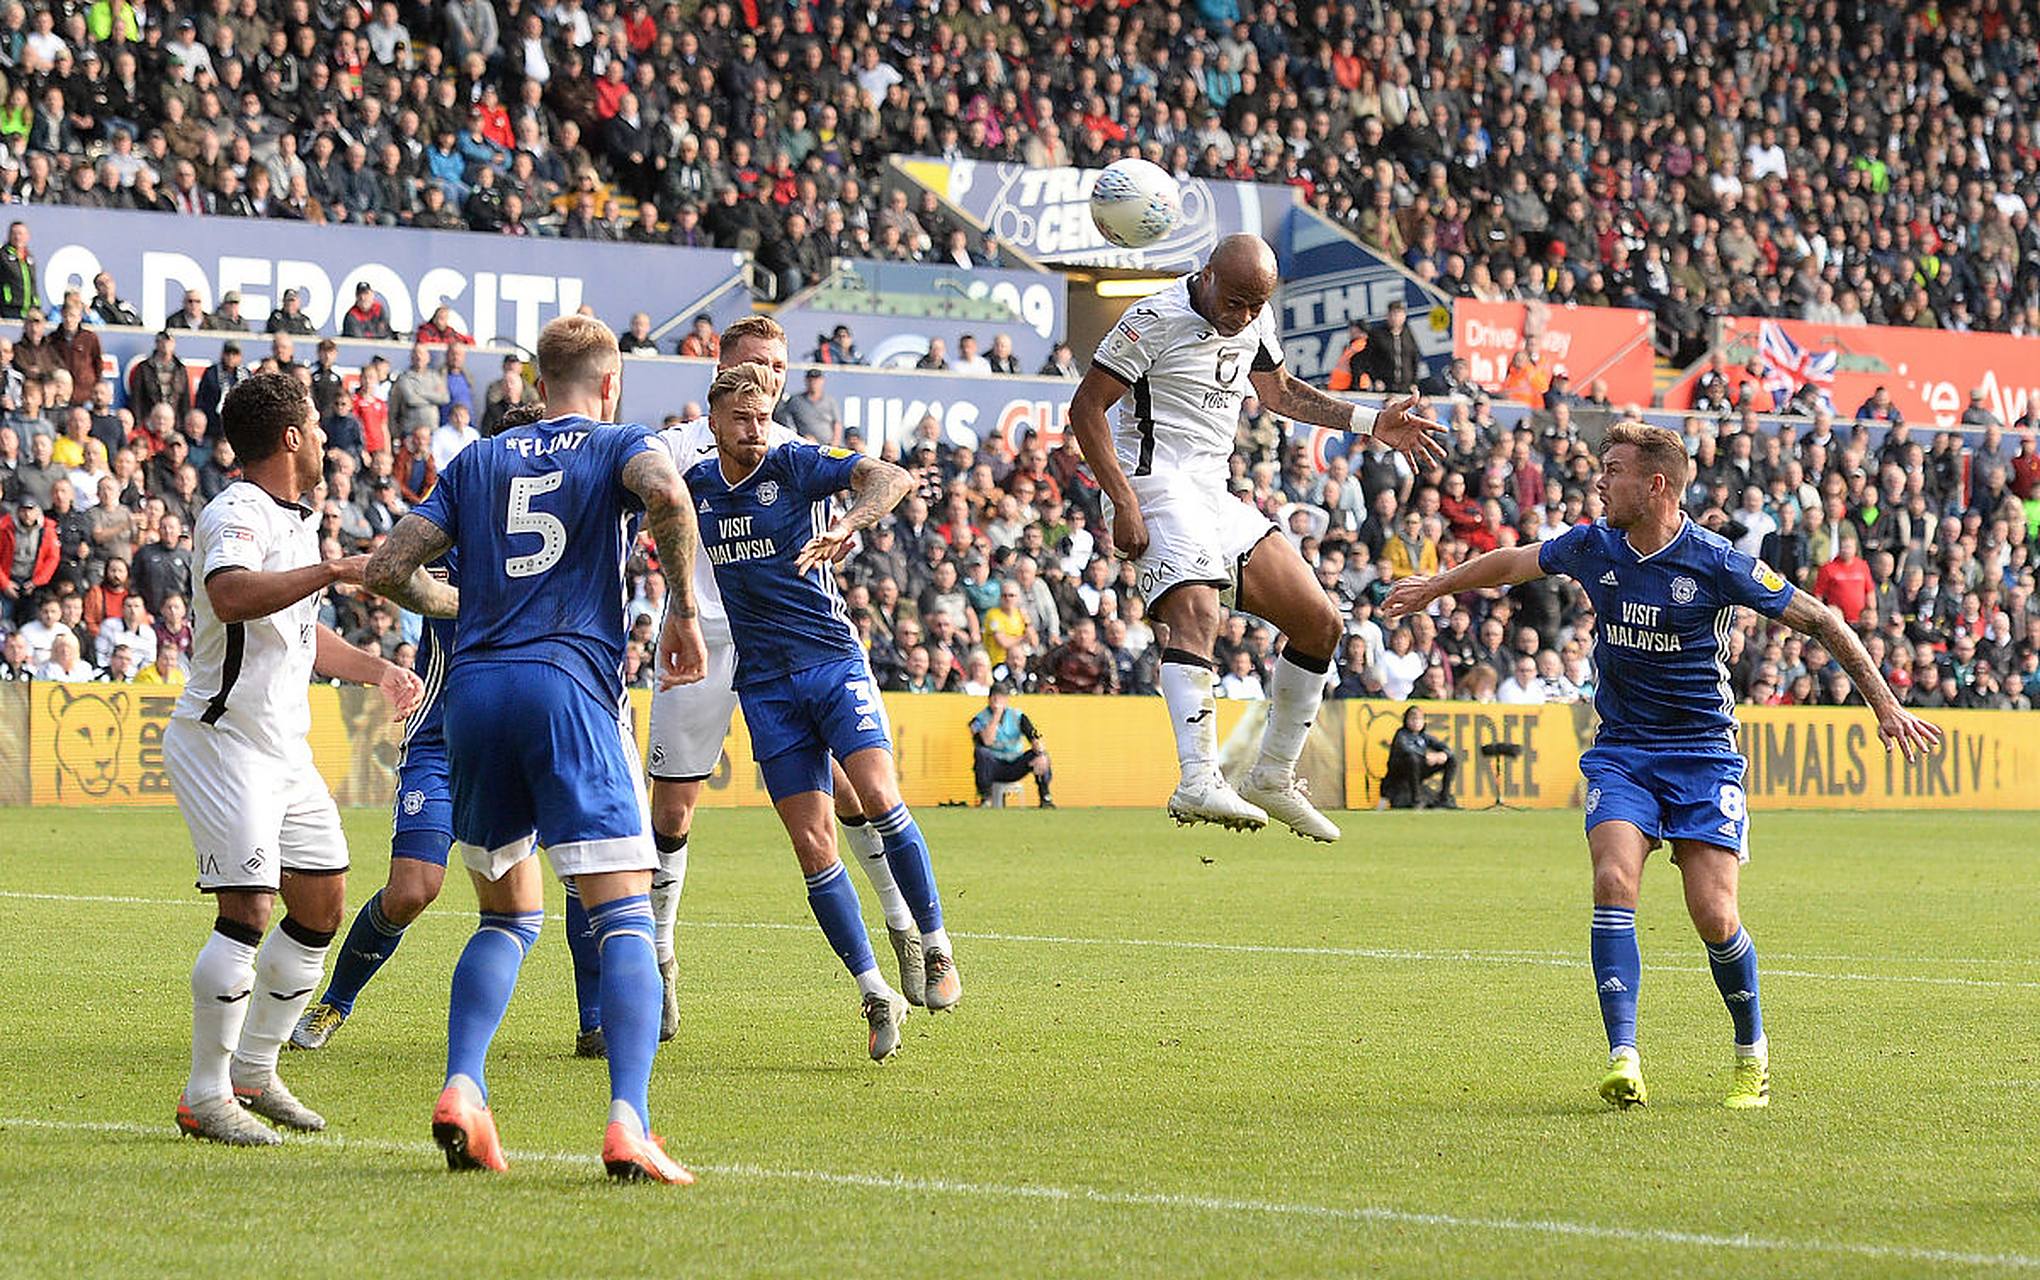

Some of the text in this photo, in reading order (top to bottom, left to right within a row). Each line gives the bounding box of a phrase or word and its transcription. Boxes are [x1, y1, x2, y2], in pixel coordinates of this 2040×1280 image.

[1465, 319, 1517, 349] Drive
[518, 431, 588, 458] FLINT
[505, 470, 567, 578] 5
[718, 515, 753, 540] VISIT
[707, 537, 776, 565] MALAYSIA
[1621, 601, 1662, 627] VISIT
[1605, 623, 1682, 652] MALAYSIA
[1454, 713, 1540, 797] FREE
[1740, 721, 1867, 796] IMALS
[1719, 784, 1743, 821] 8
